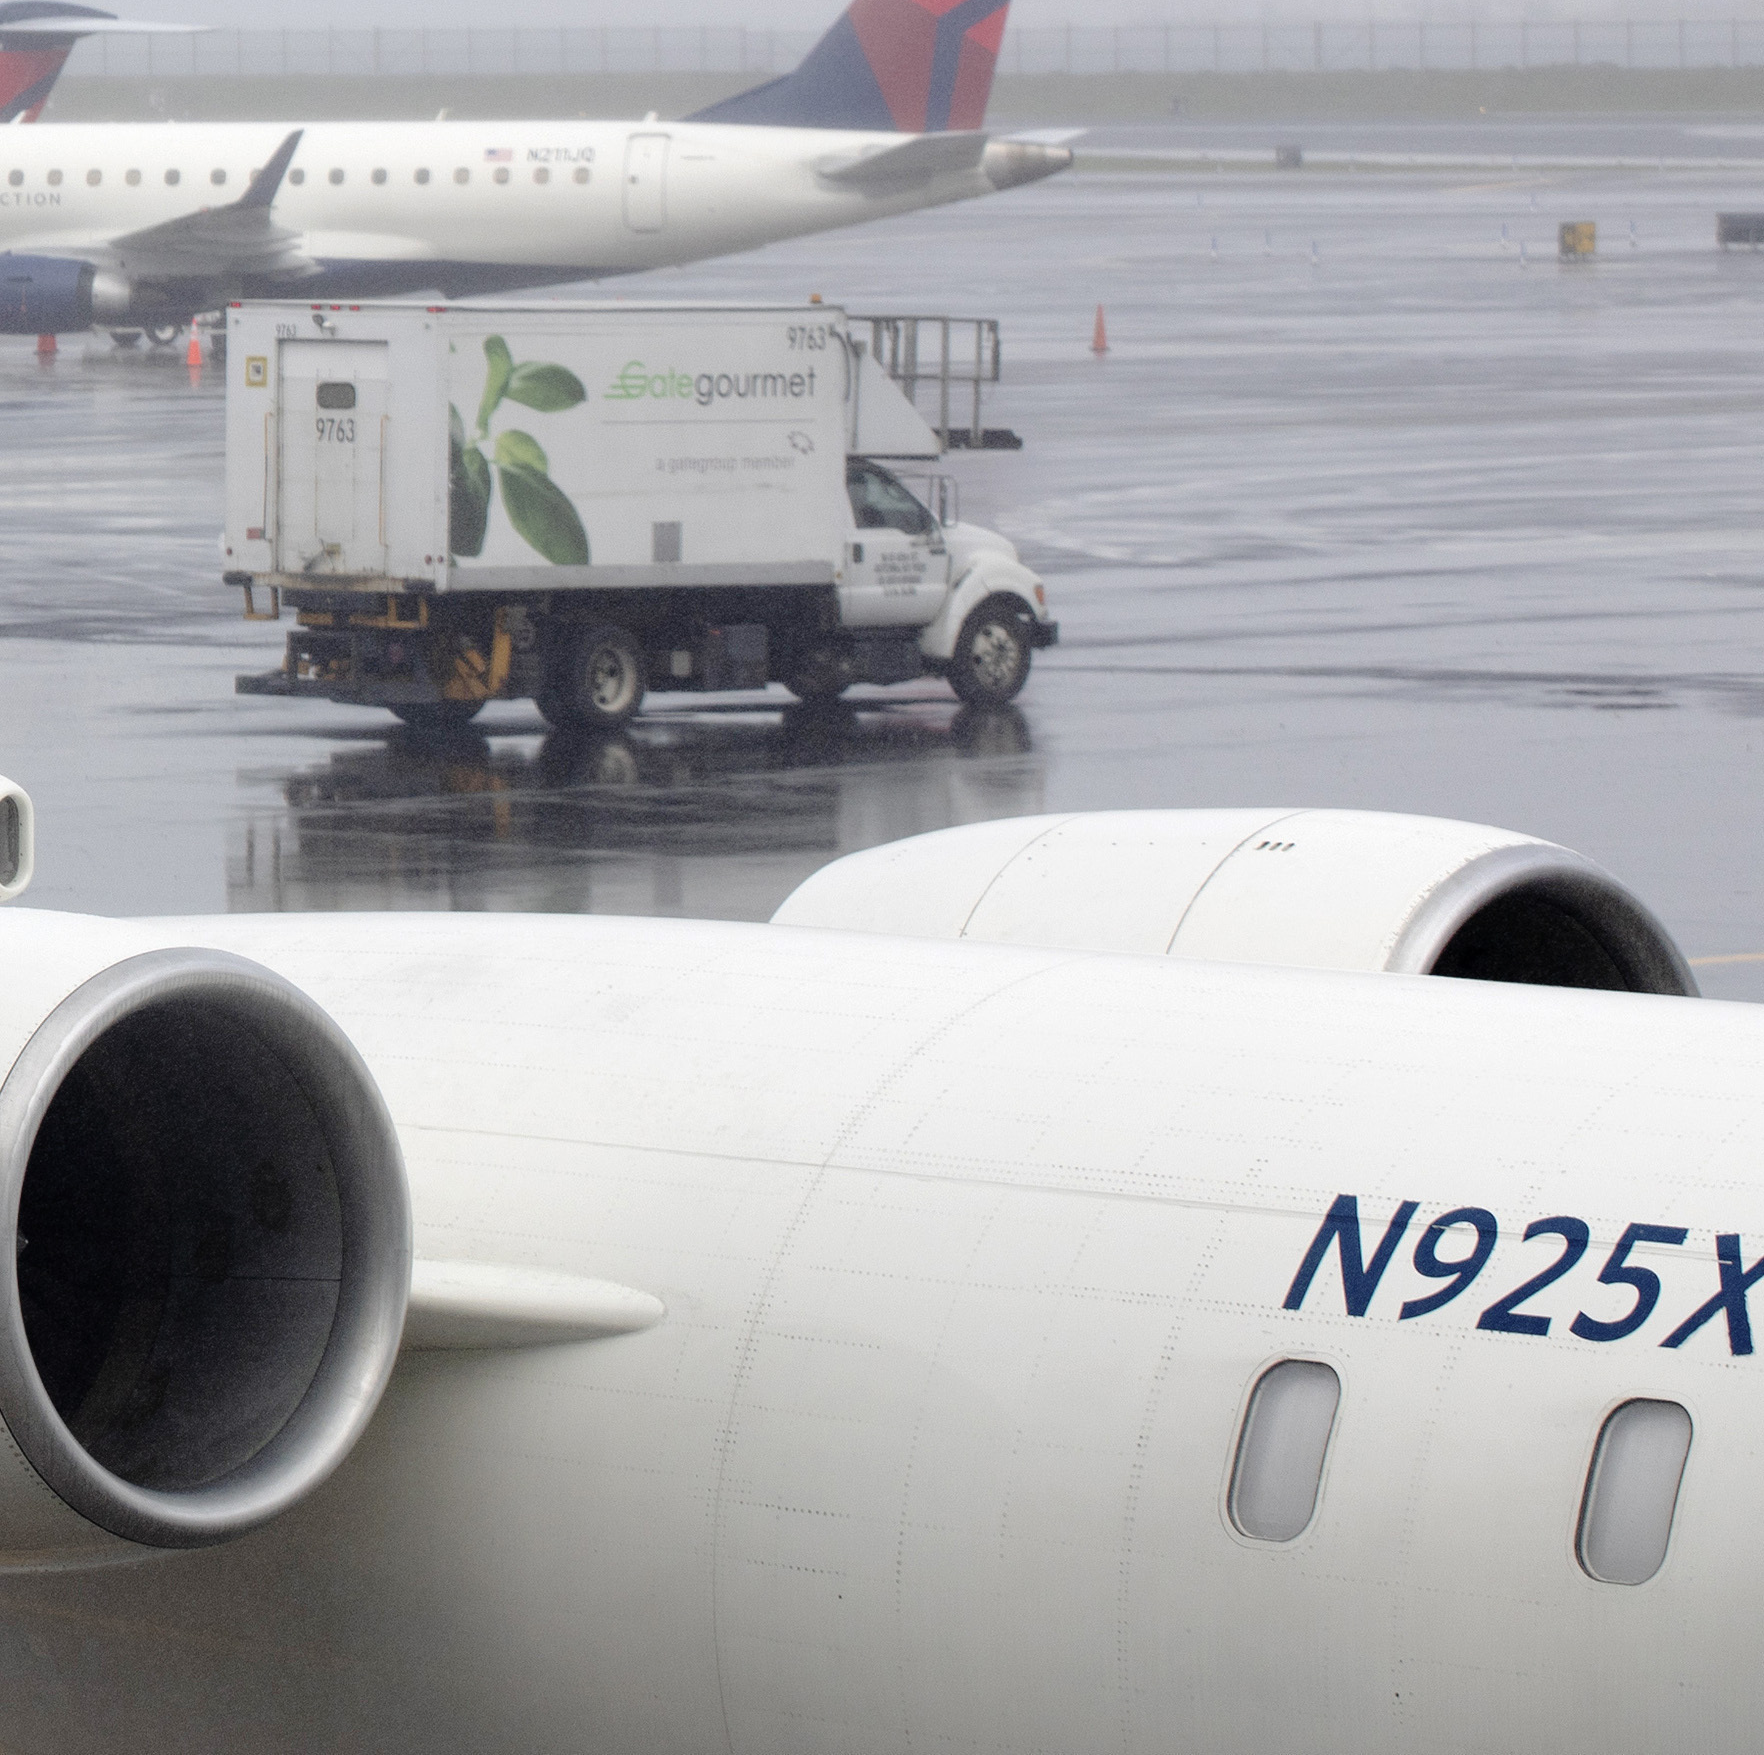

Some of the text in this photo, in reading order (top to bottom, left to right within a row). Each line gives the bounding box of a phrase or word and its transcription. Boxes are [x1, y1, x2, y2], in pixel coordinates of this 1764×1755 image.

[275, 324, 296, 336] 9763
[787, 326, 826, 350] 9763
[316, 417, 355, 442] 9763
[1281, 1193, 1764, 1356] N925X
